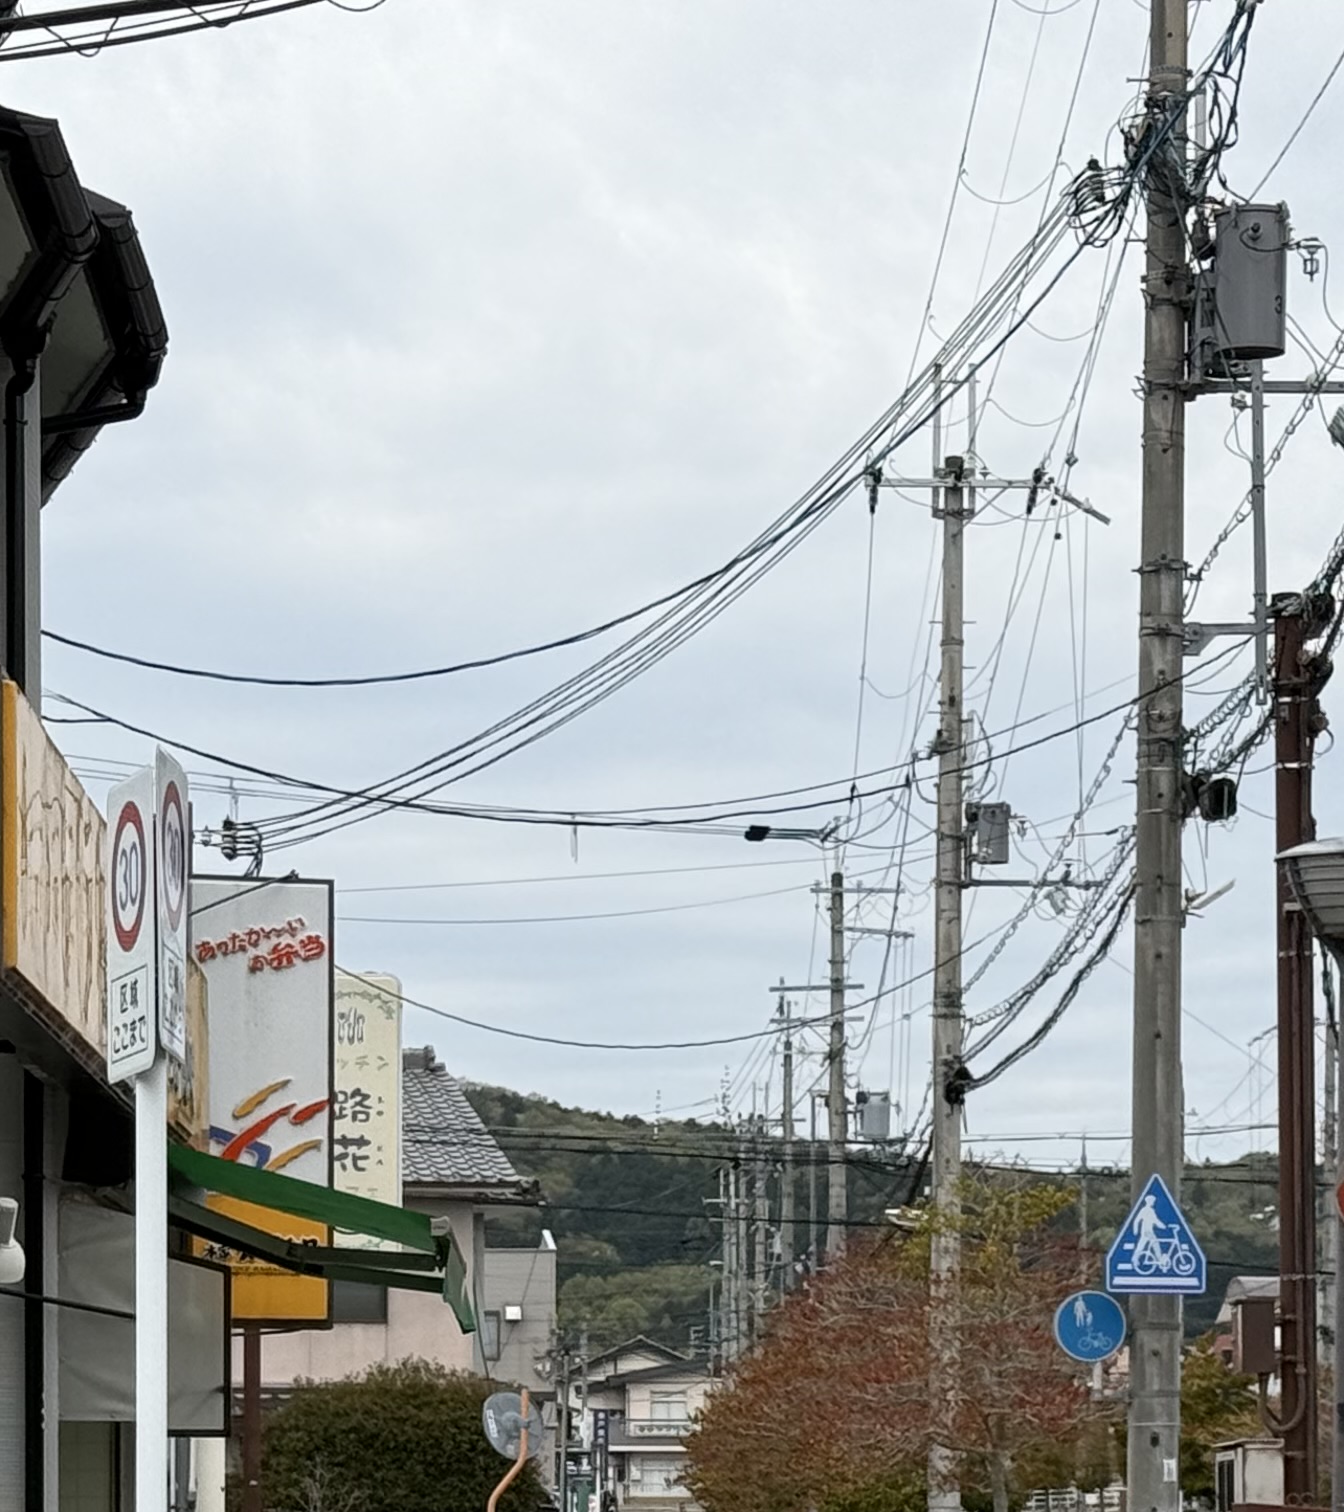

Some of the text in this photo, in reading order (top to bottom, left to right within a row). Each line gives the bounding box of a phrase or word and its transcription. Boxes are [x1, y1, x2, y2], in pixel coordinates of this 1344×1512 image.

[1274, 294, 1283, 316] 3
[118, 840, 139, 911] 30
[247, 934, 326, 974] お弁当
[118, 976, 139, 1015] 区域
[112, 1013, 147, 1054] ここまで
